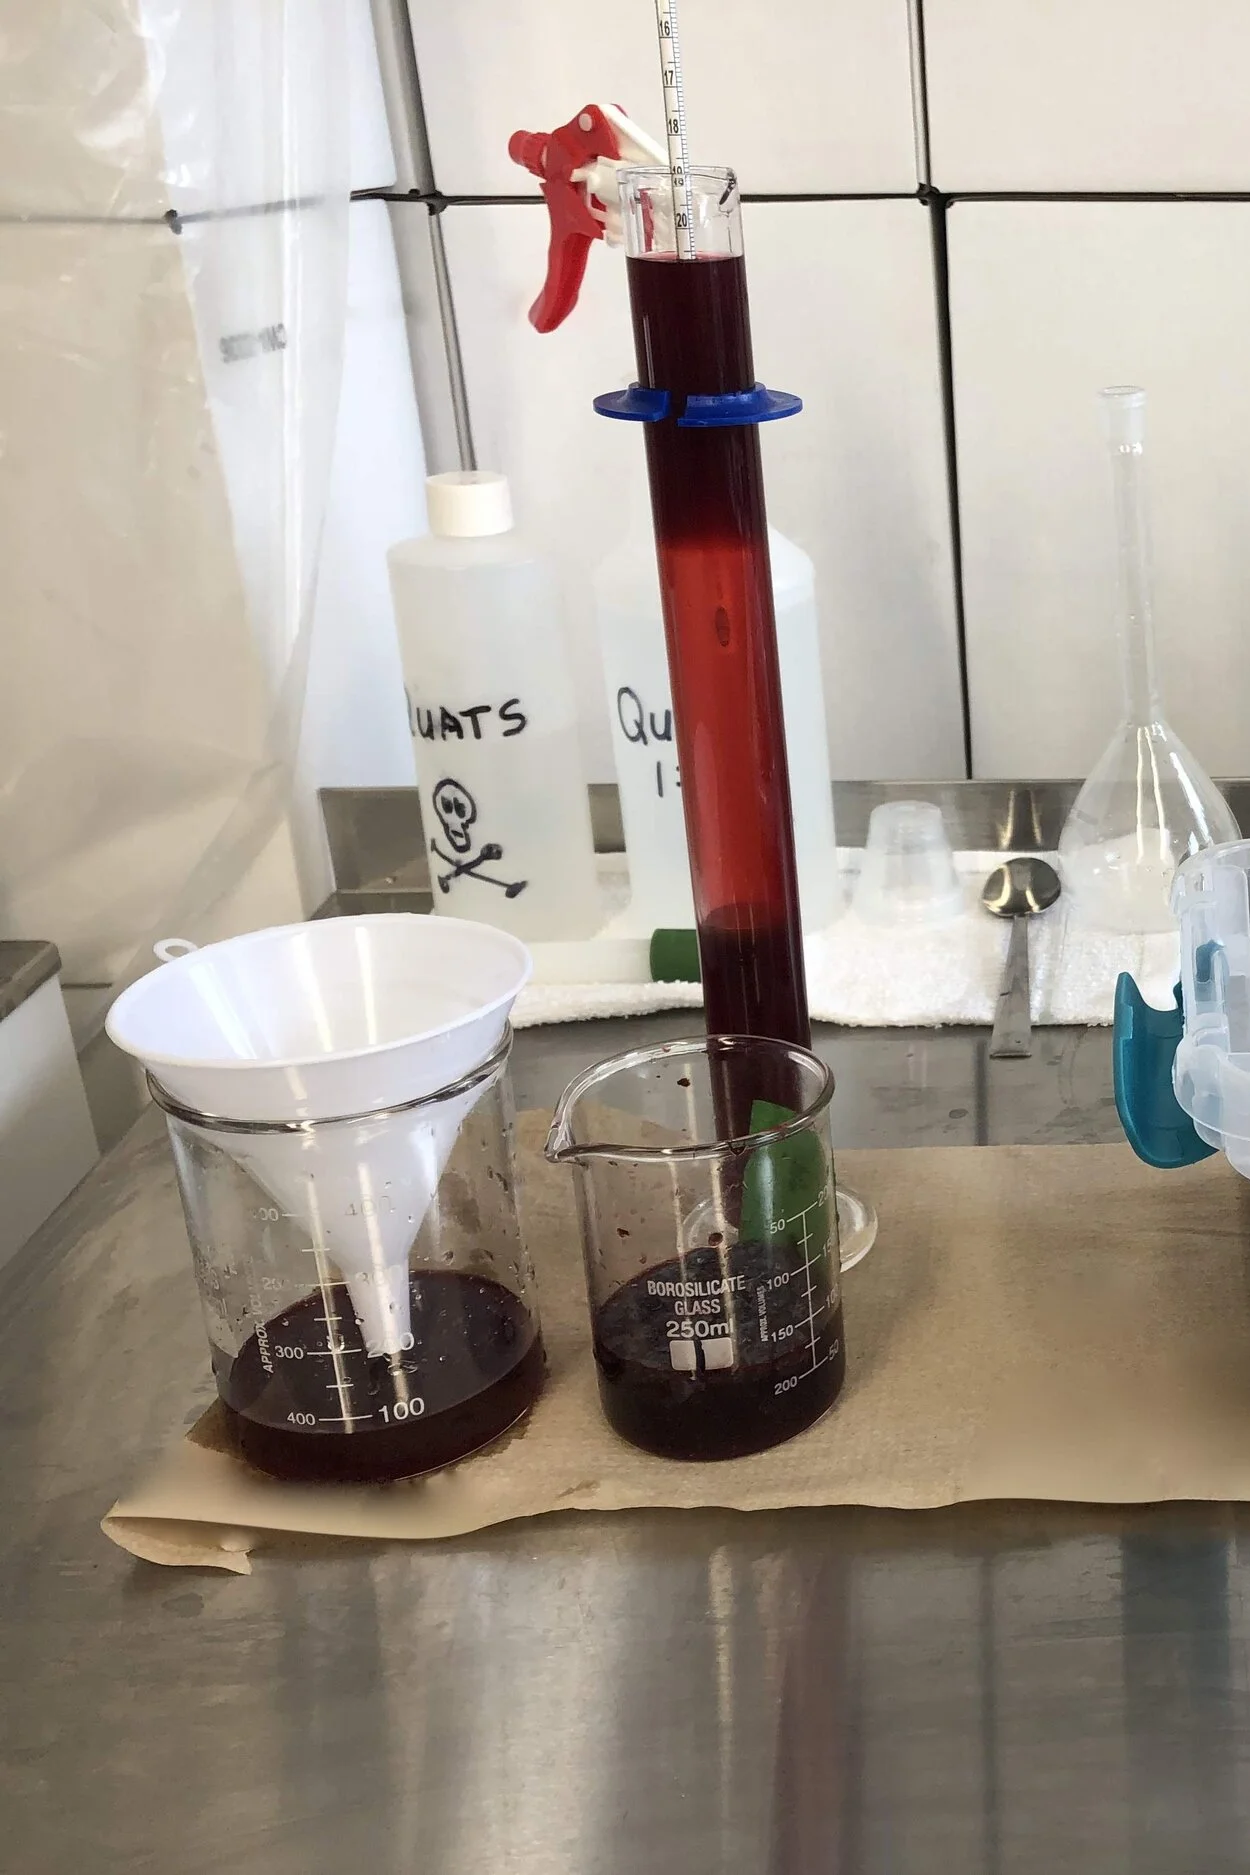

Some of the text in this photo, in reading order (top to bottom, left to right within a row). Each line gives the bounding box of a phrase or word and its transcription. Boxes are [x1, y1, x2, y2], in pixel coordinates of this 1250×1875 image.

[659, 20, 671, 36] 16
[664, 70, 674, 85] 17
[668, 118, 679, 133] 18
[676, 212, 688, 227] 20
[404, 686, 527, 741] UATS
[253, 1207, 279, 1222] 00
[769, 1218, 786, 1234] 50
[647, 1275, 746, 1297] BOROSILICATE
[767, 1273, 790, 1290] 100
[674, 1299, 721, 1316] GLASS
[666, 1317, 734, 1338] 250ml
[771, 1324, 794, 1342] 150
[275, 1345, 305, 1360] 300
[774, 1375, 798, 1395] 200
[378, 1396, 425, 1424] 100
[287, 1412, 316, 1426] 400
